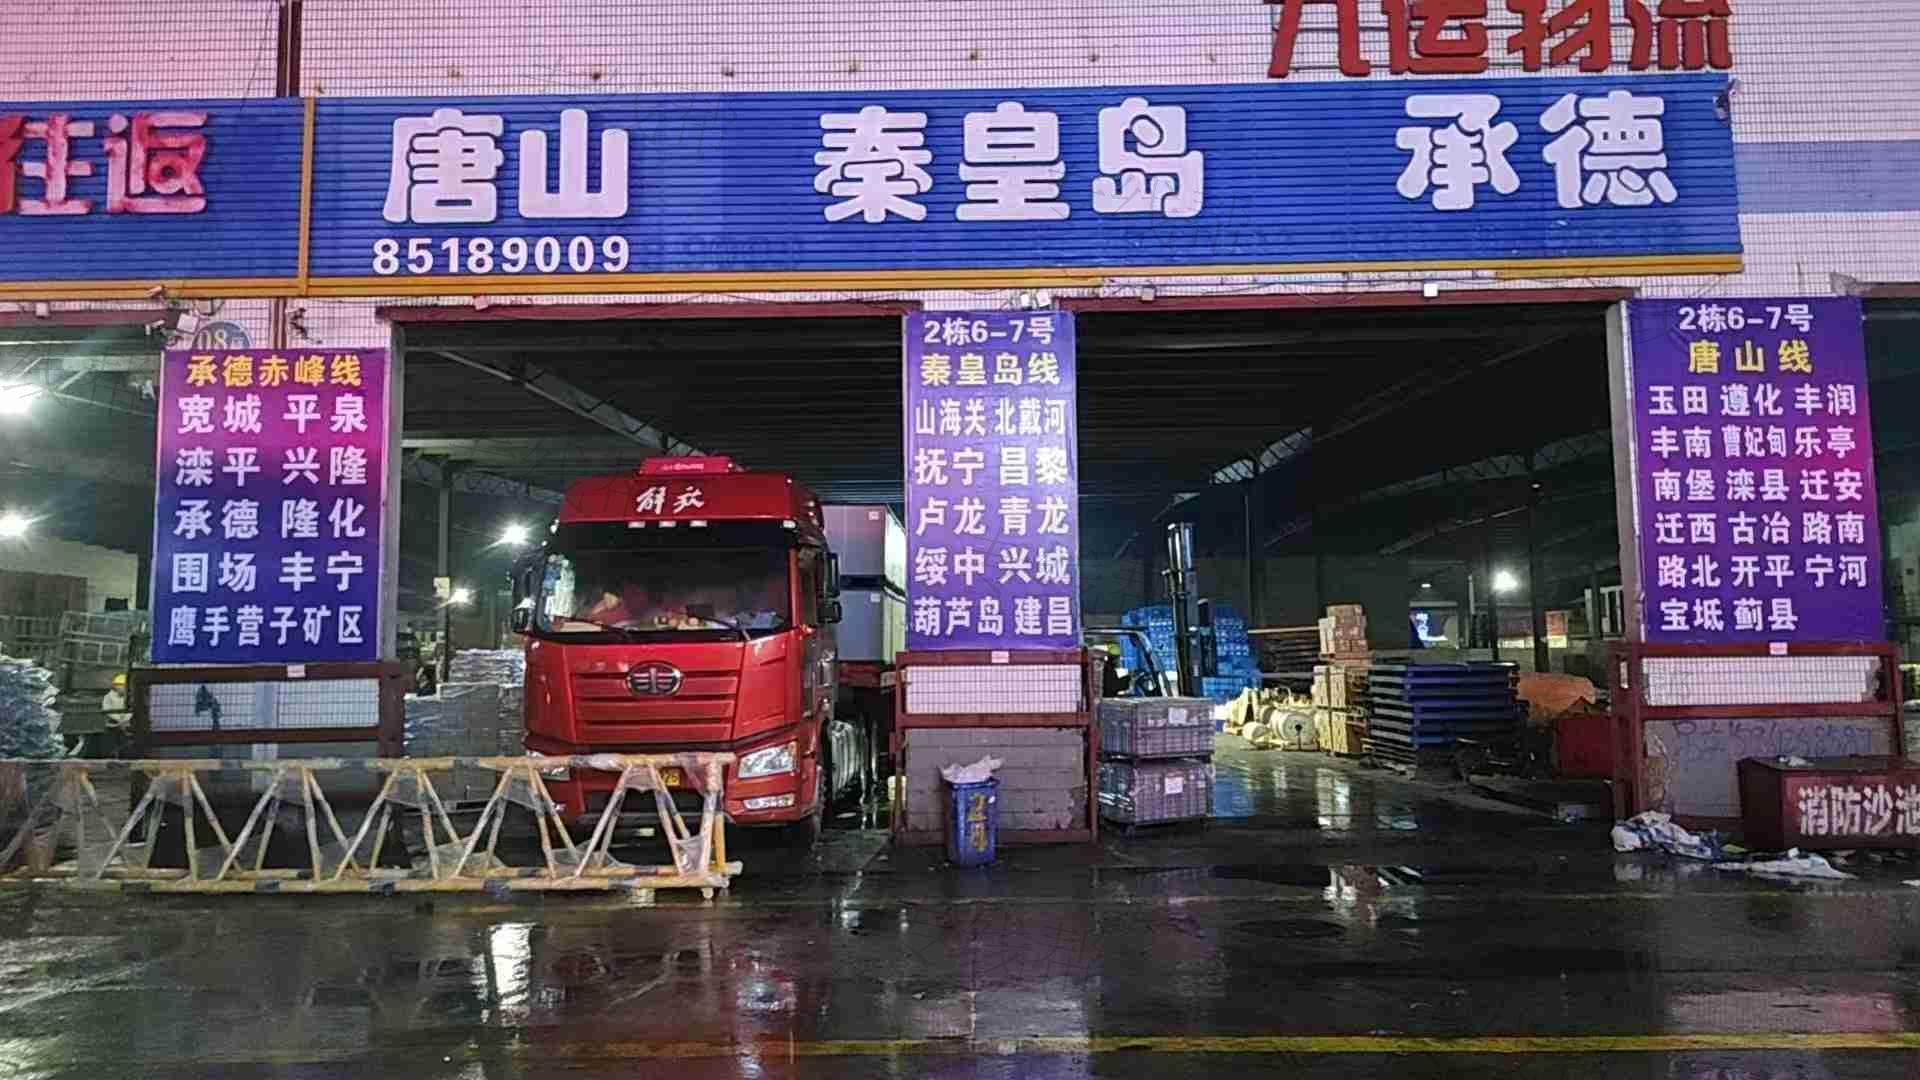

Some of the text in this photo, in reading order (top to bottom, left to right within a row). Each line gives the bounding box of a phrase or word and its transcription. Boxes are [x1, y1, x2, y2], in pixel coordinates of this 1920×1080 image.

[0, 113, 207, 215] 往返
[383, 90, 1678, 224] 唐山 秦皇岛 承德
[372, 236, 630, 275] 85189009
[924, 317, 1055, 346] 2栋6-7号
[1679, 303, 1813, 332] 2栋6-7号
[186, 355, 362, 387] 承德赤峰线
[920, 353, 1060, 386] 秦皇岛线
[1688, 340, 1813, 374] 唐山线
[177, 393, 368, 434] 宽城 平泉
[915, 398, 1066, 436] 山海关 北戴河
[1649, 384, 1856, 417] 玉田 遵化 丰润
[1651, 425, 1856, 458] 丰南 曹妃甸 乐亭
[176, 447, 368, 486] 滦平 兴隆
[915, 447, 1068, 486] 抚宁 昌黎
[1652, 469, 1863, 501] 南堡 滦县 迁安
[174, 498, 365, 539] 承德 隆化
[915, 497, 1069, 535] 卢龙 青龙
[1655, 511, 1864, 544] 迁西 古冶 路南
[172, 551, 363, 593] 围场 丰宁
[915, 547, 1071, 586] 绥中 兴城
[1657, 555, 1867, 588] 路北 开平 宁河
[168, 606, 364, 647] 鹰手营子矿区
[914, 596, 1073, 637] 葫芦岛 建昌
[1661, 598, 1798, 632] 宝坻 蓟县
